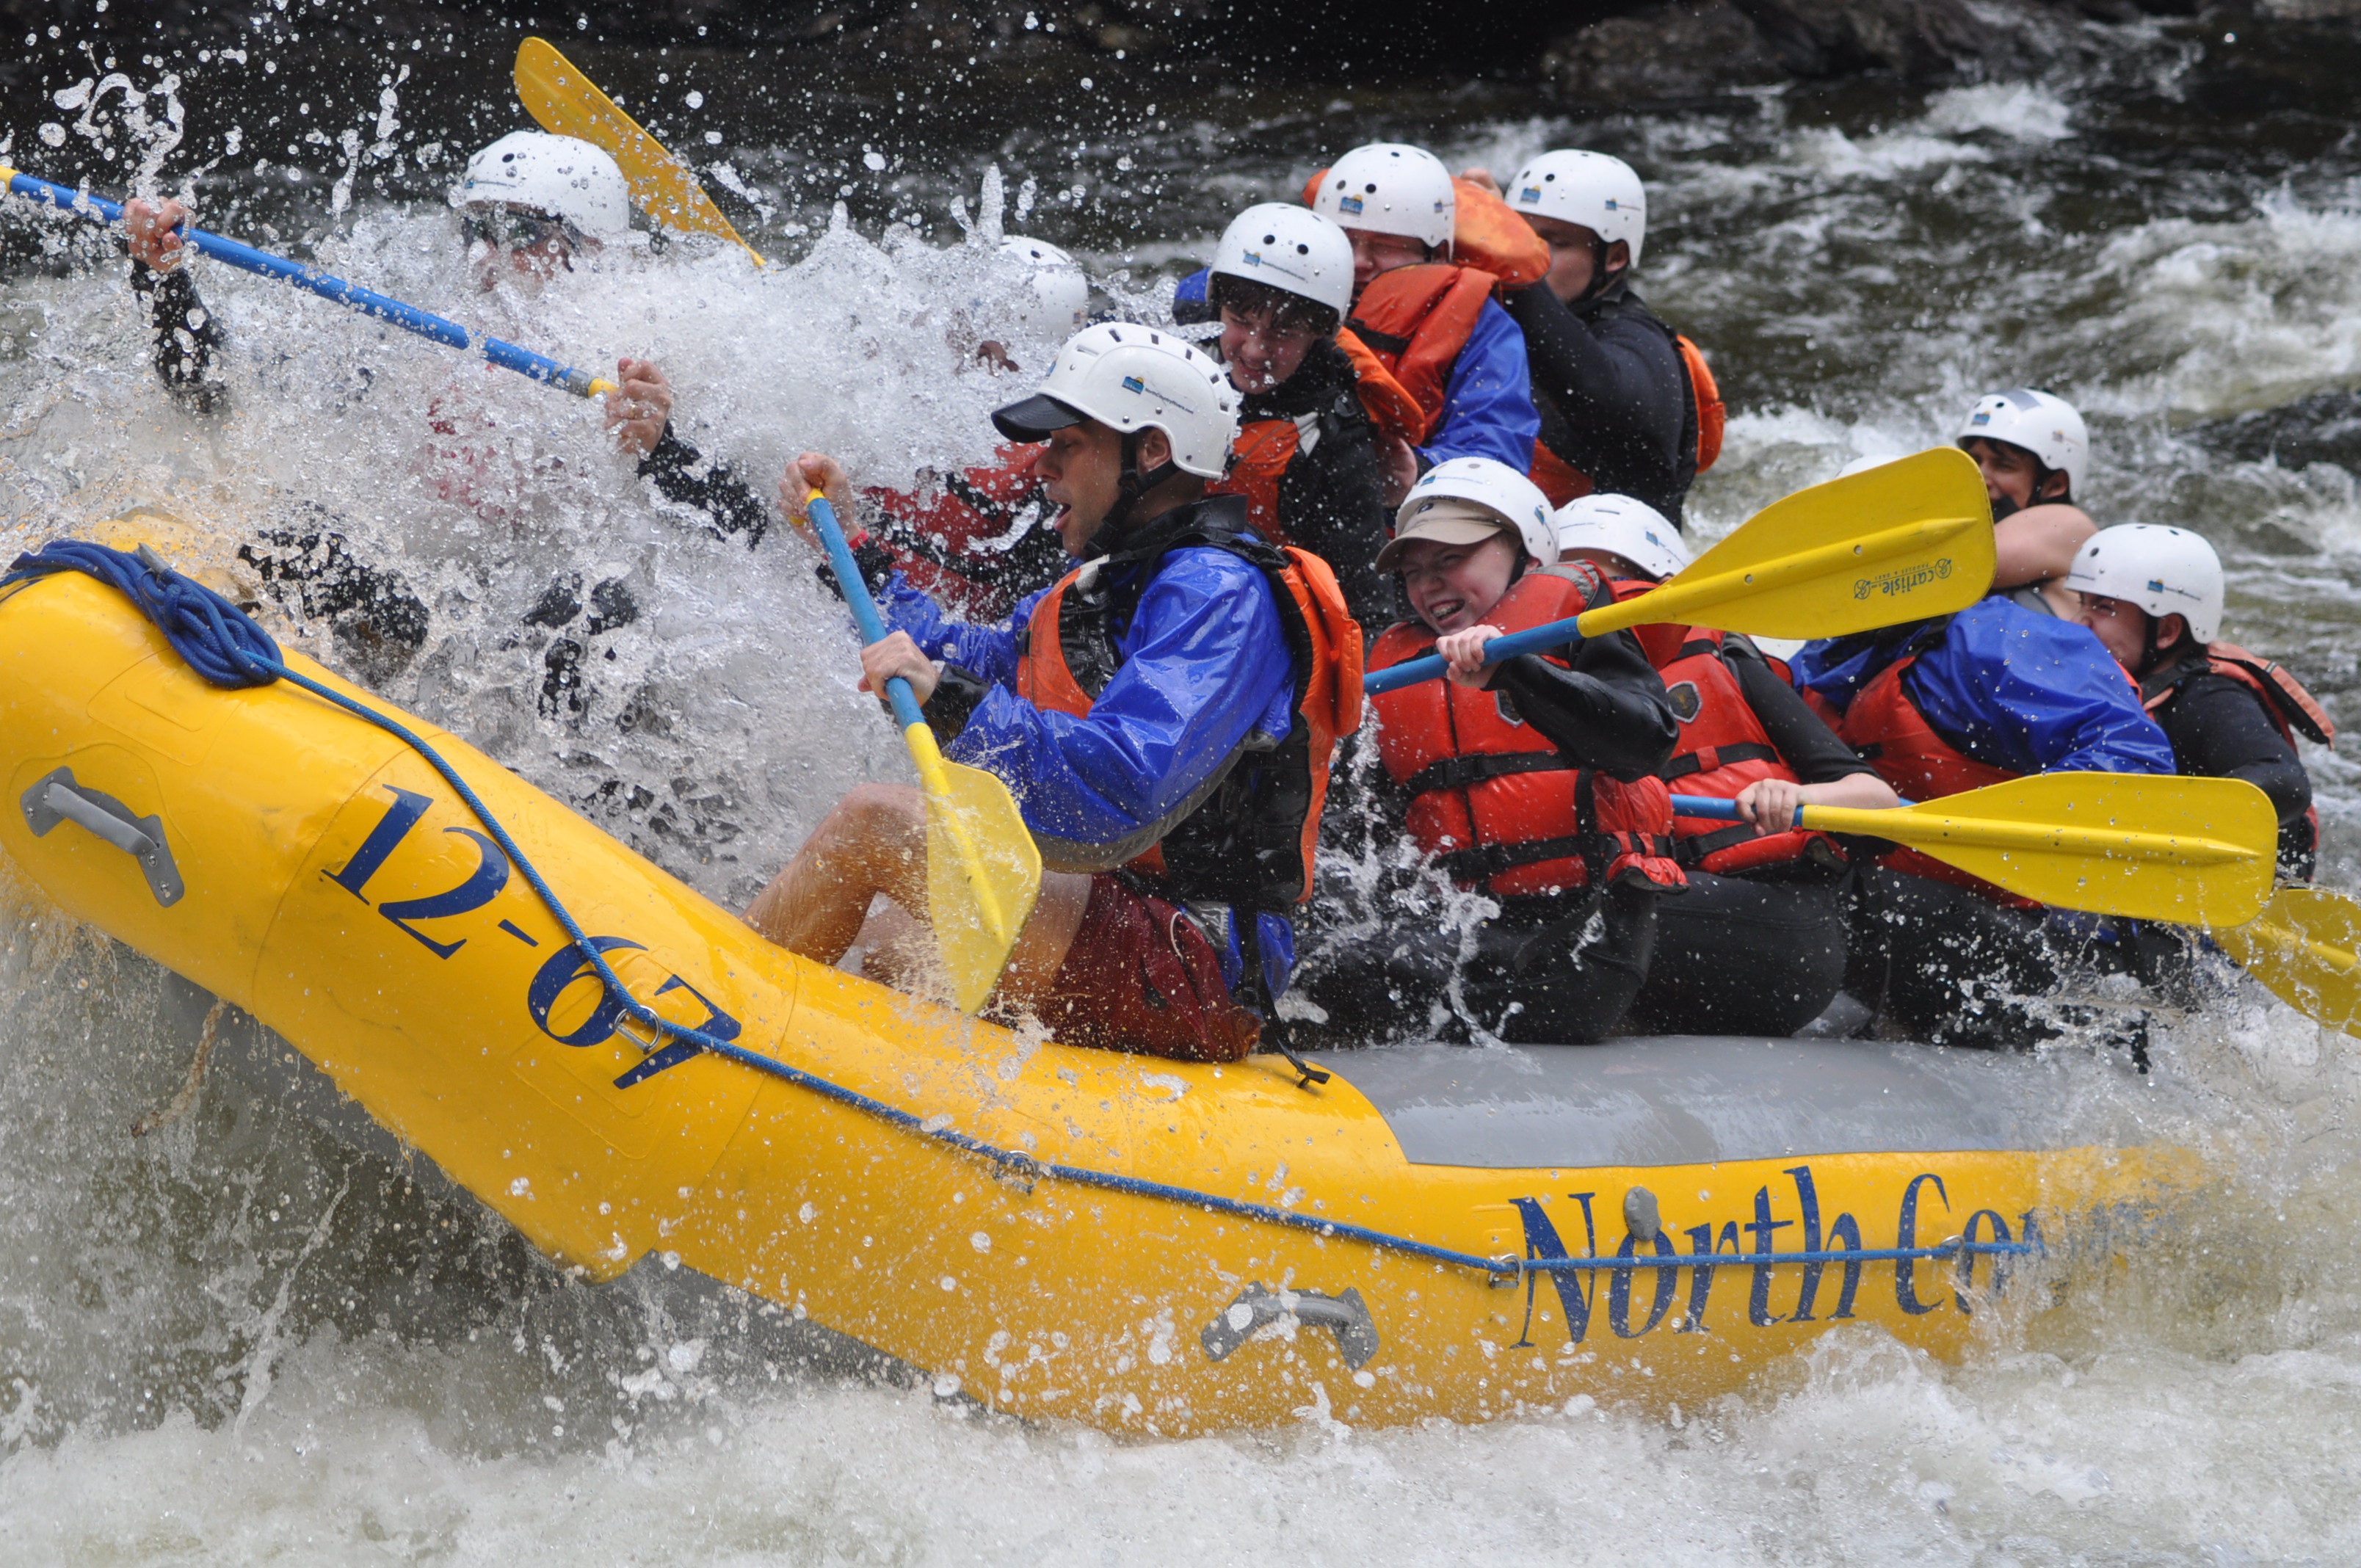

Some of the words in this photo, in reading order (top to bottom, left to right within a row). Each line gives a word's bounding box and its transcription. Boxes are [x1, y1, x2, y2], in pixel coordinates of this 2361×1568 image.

[1882, 570, 1934, 596] carlisle
[319, 783, 742, 1090] 12-67
[1508, 1165, 1860, 1350] North
